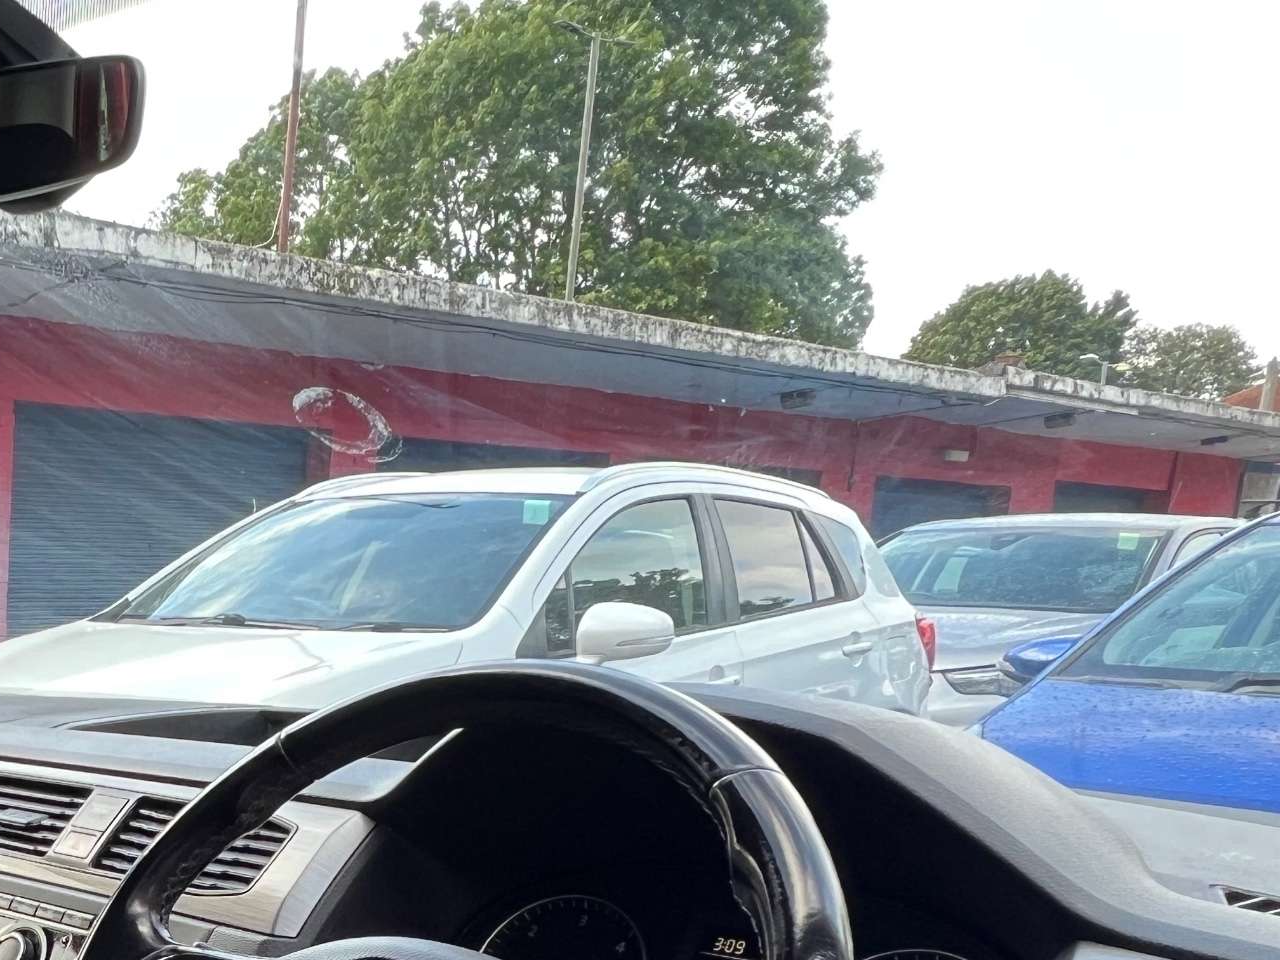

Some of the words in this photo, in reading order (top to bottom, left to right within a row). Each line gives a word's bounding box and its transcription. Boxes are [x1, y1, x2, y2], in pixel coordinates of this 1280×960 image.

[579, 915, 588, 926] 3
[528, 925, 539, 937] 2
[713, 937, 746, 955] 3:09
